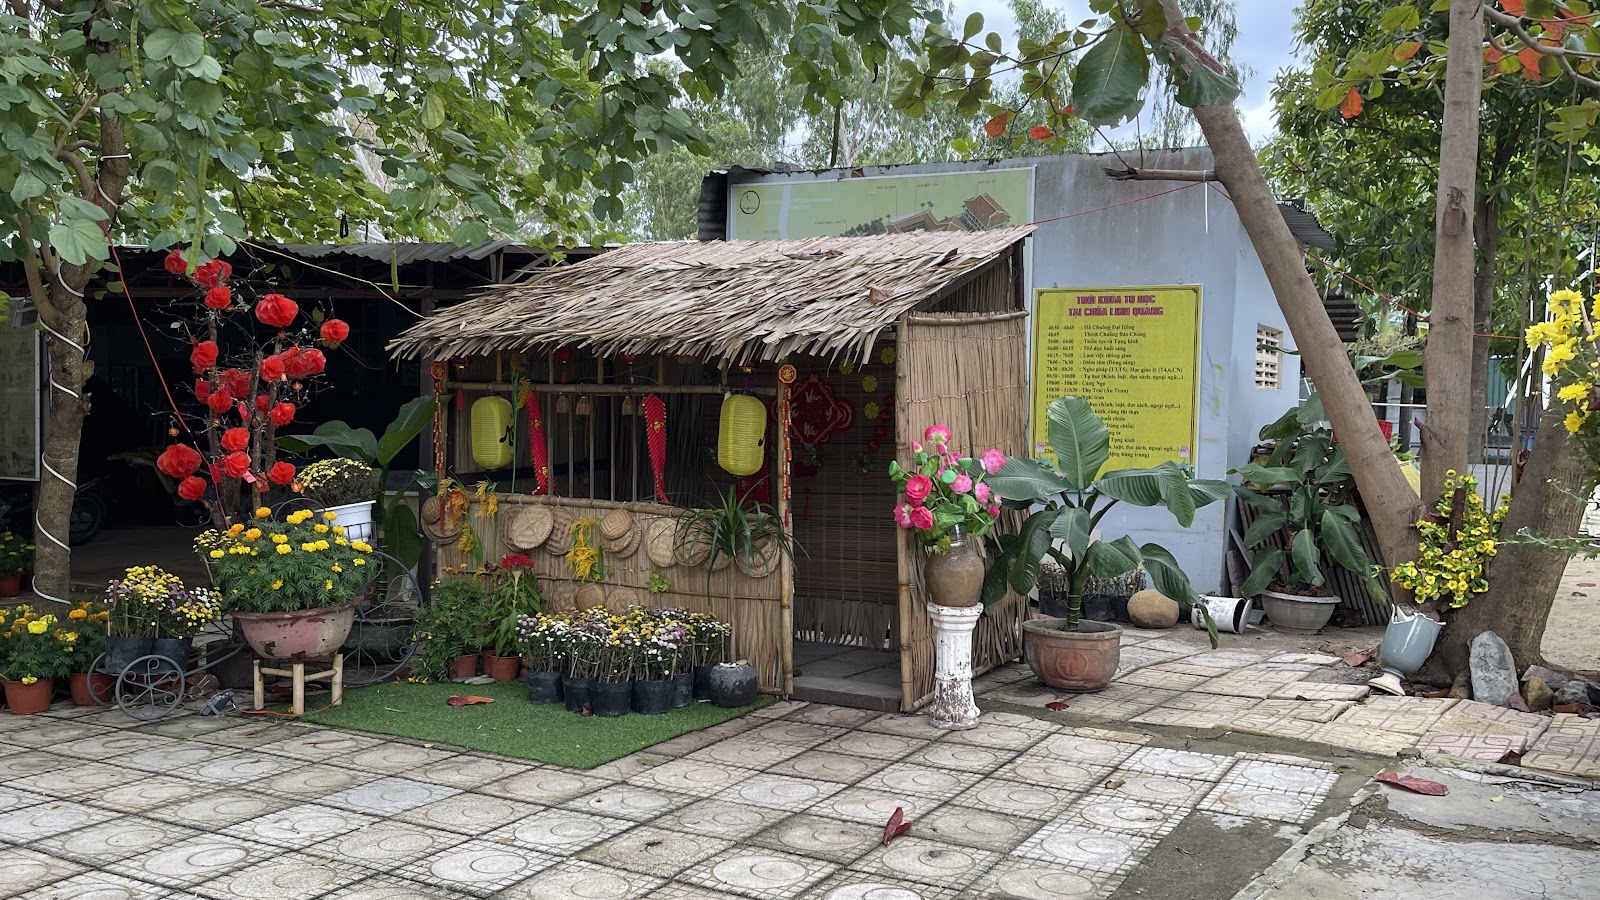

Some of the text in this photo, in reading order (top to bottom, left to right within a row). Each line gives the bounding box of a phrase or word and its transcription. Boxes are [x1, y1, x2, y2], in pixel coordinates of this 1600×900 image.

[1124, 295, 1136, 304] TU
[1137, 294, 1156, 305] HỌC
[1068, 306, 1164, 318] TẠI CHÙA LINH QUANG
